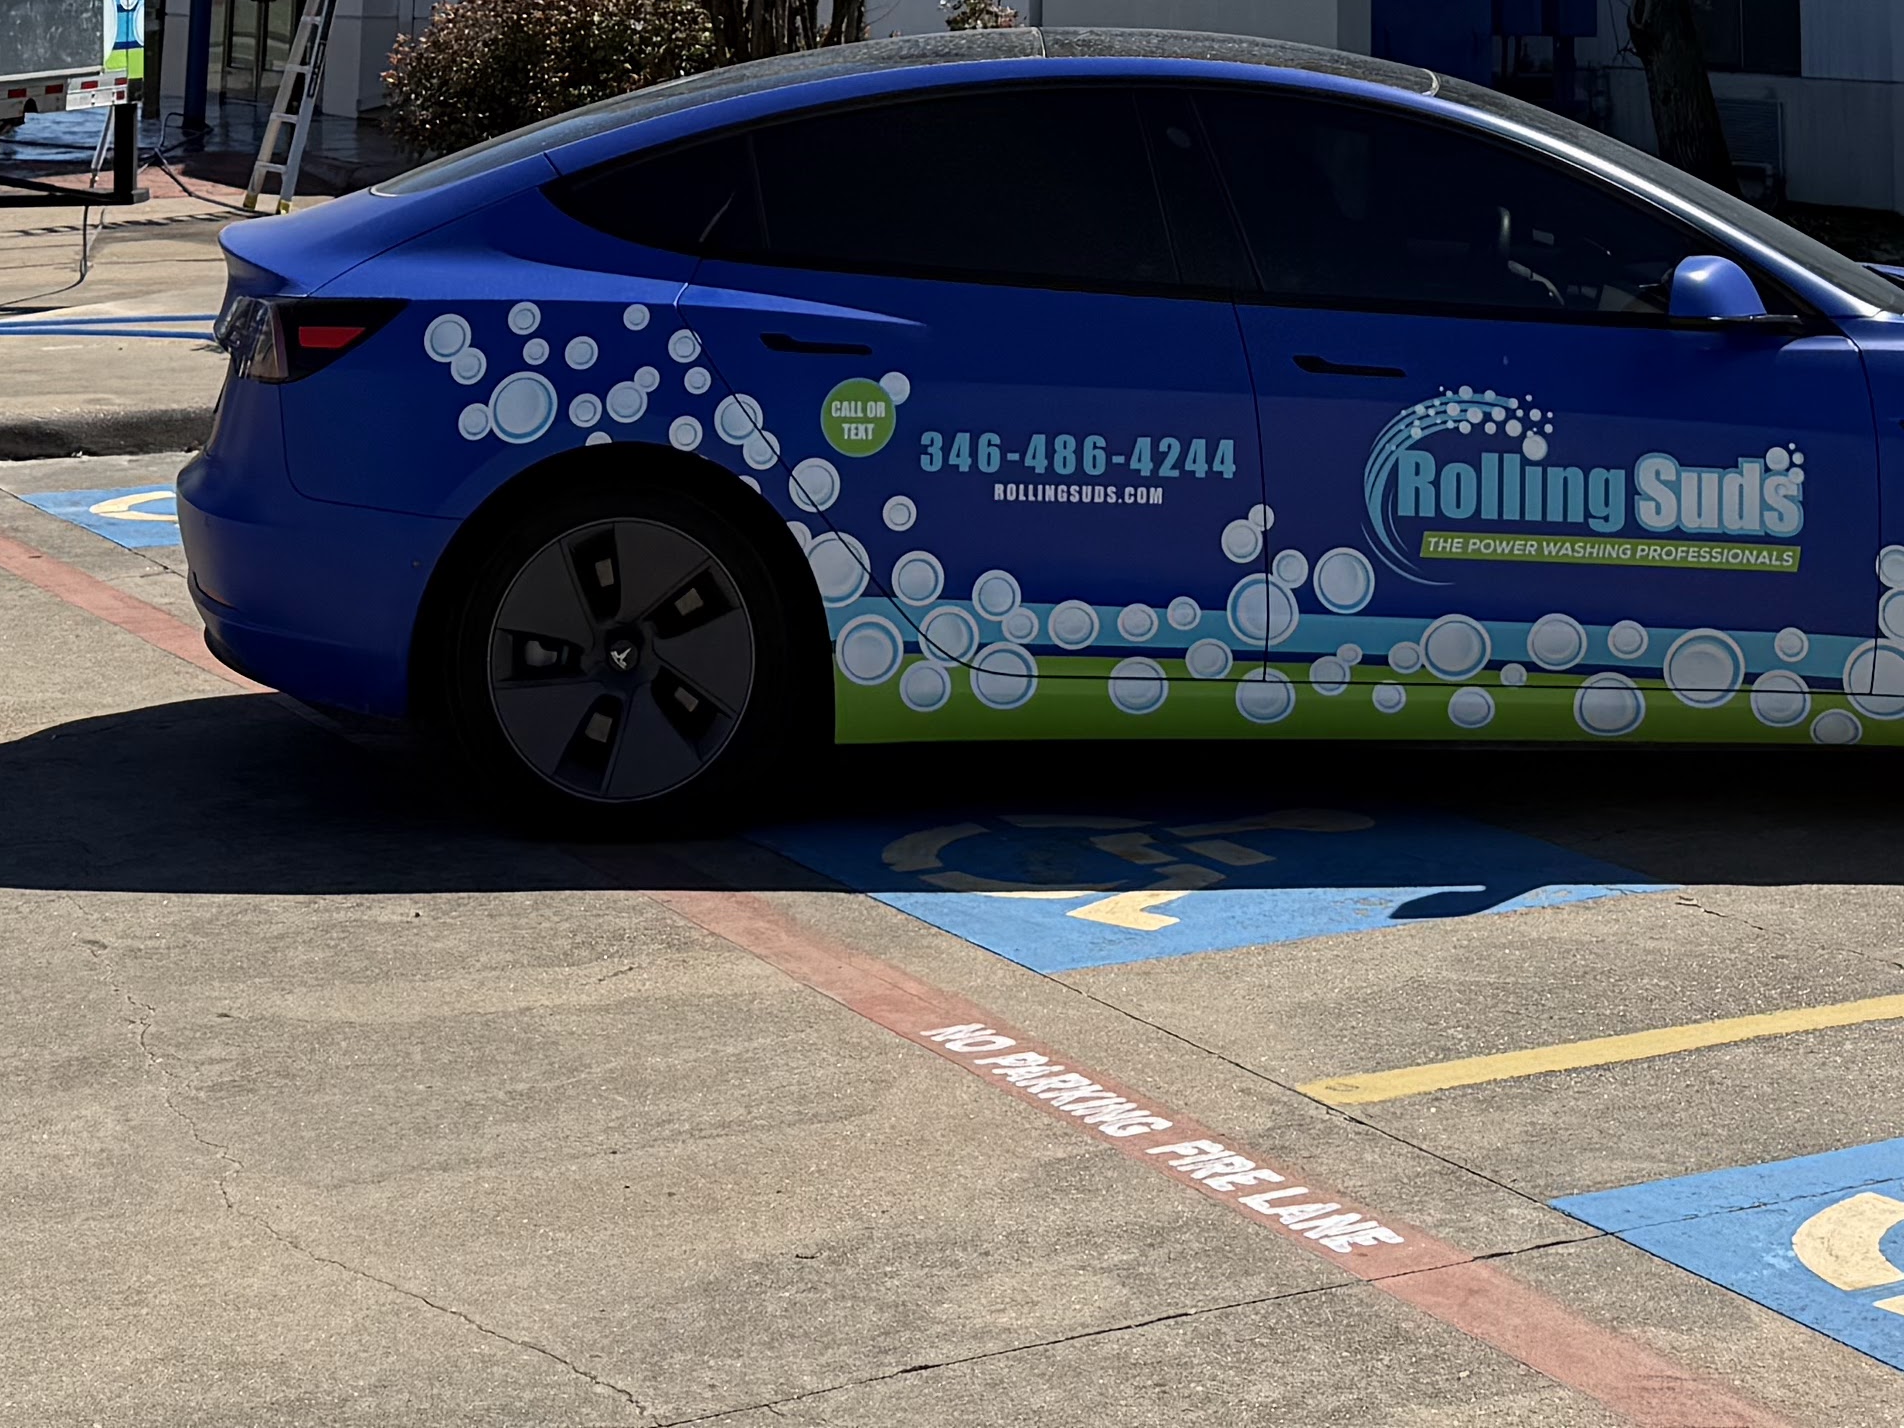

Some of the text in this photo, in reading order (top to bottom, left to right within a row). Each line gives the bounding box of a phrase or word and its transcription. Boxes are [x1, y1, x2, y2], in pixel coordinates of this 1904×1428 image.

[831, 401, 886, 418] CALL OR
[842, 423, 874, 440] TEXT
[920, 431, 1236, 479] 346-486-4244
[994, 483, 1163, 505] ROLLINGSUDS.COM
[1397, 449, 1805, 537] Rolling Suds
[1427, 537, 1794, 567] THE POWER WASHING PROFESSIONALS
[920, 1022, 1405, 1254] NO PARKING FIRE LANE
